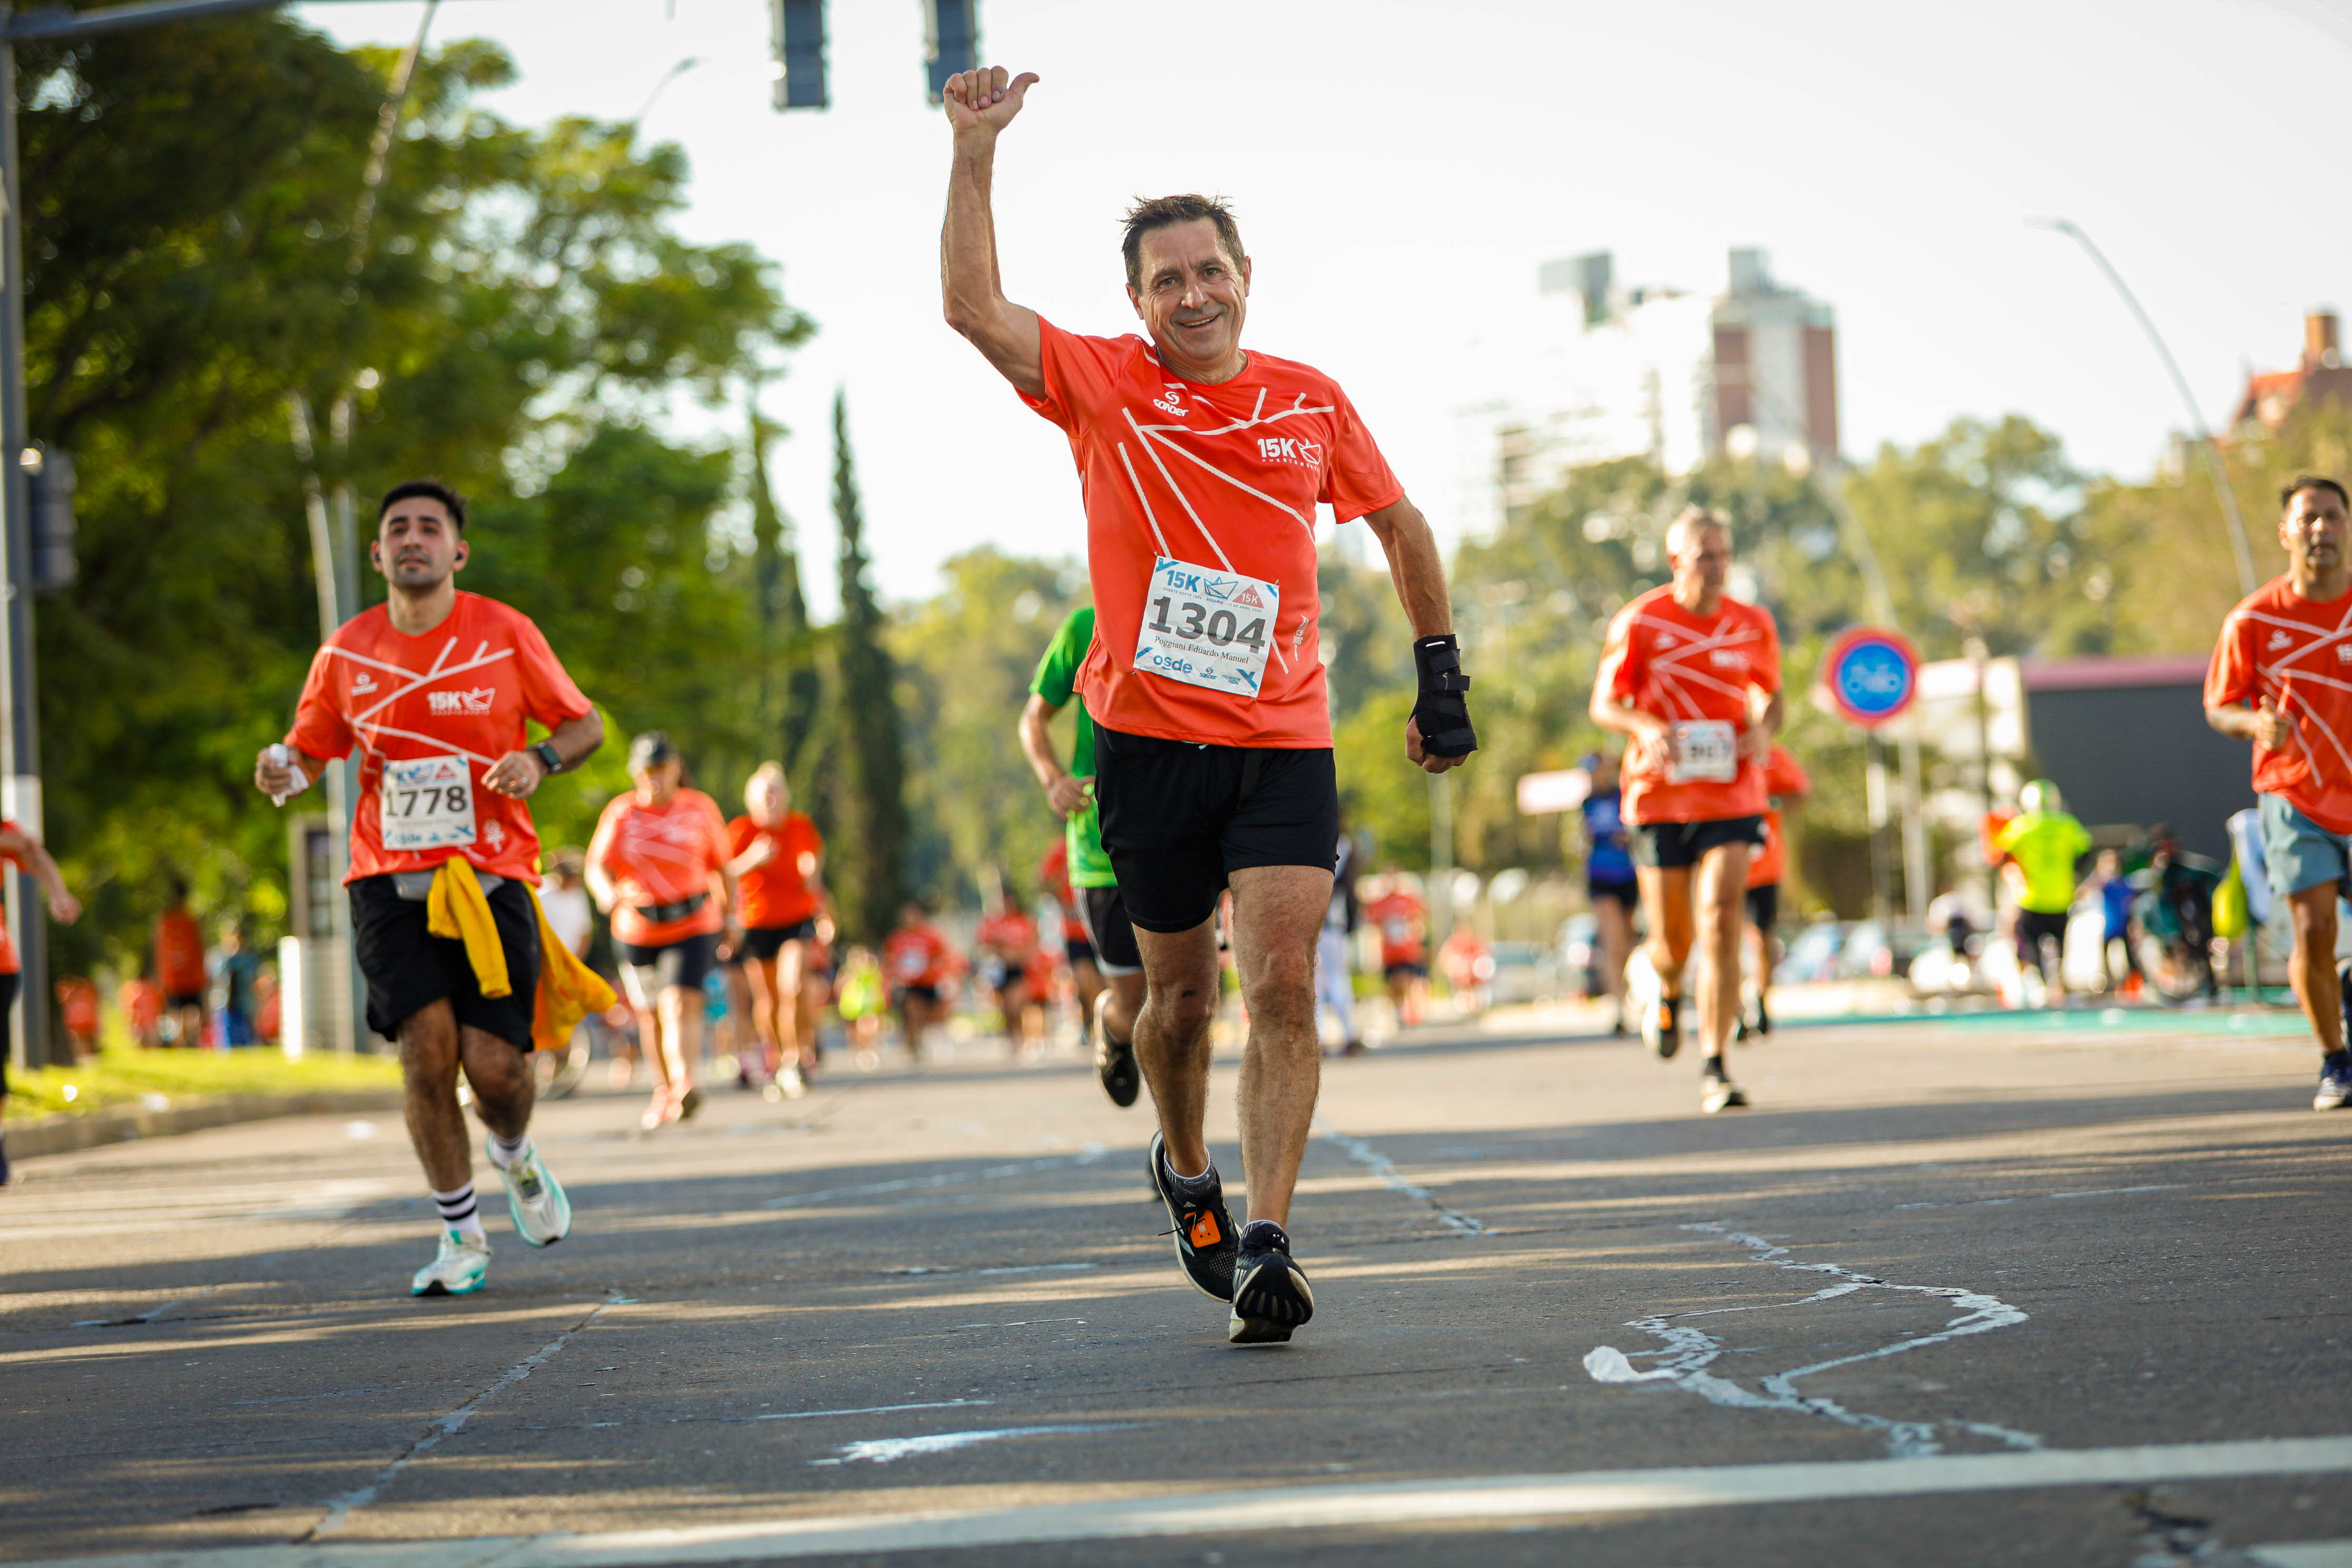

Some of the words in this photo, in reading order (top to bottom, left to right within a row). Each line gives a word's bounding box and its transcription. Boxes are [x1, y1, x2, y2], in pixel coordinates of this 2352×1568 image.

[1257, 438, 1297, 458] 15K
[1167, 570, 1201, 592] 15K
[1241, 593, 1259, 604] 15K
[1148, 596, 1266, 654] 1304
[1155, 636, 1186, 650] Poggiani
[1188, 644, 1219, 657] Eduardo
[1220, 651, 1249, 664] Manuel
[1153, 655, 1193, 673] osde
[426, 691, 462, 711] 15K
[385, 786, 467, 817] 1778
